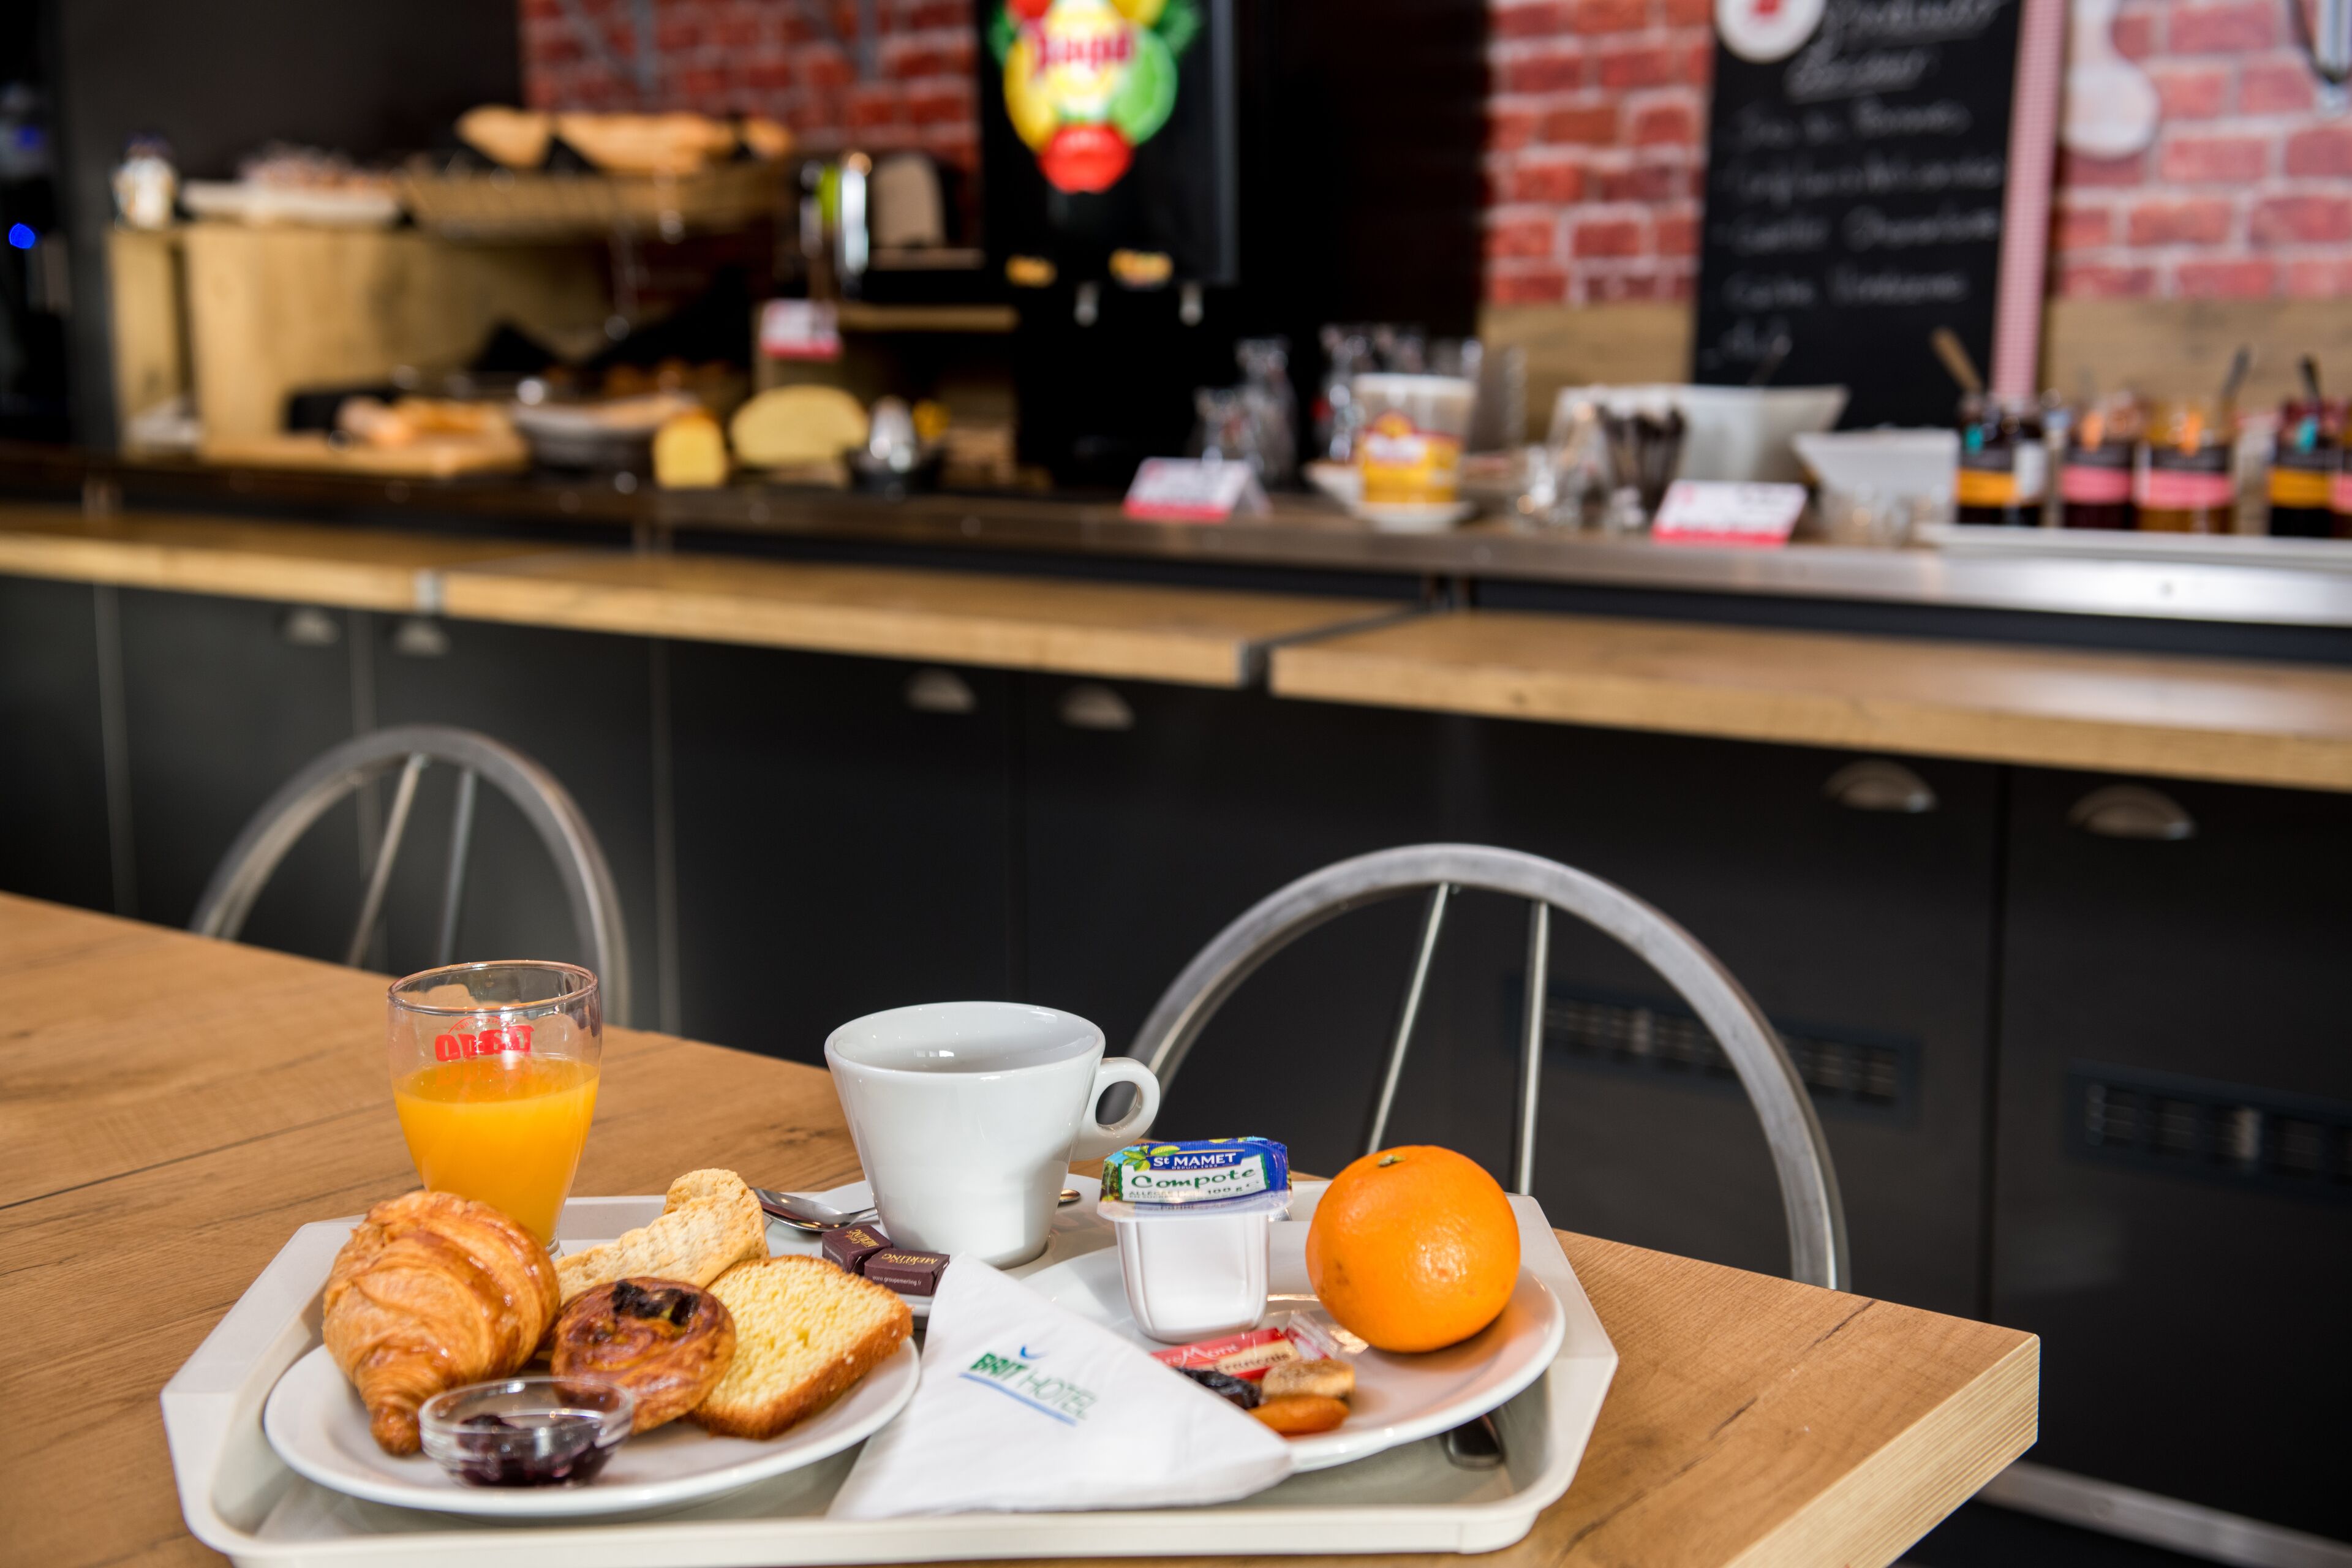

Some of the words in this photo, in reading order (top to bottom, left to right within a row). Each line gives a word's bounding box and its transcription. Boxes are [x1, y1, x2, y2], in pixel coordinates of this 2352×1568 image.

[1153, 1156, 1170, 1167] St
[1174, 1152, 1237, 1167] MAMET
[1131, 1167, 1256, 1189] Compote
